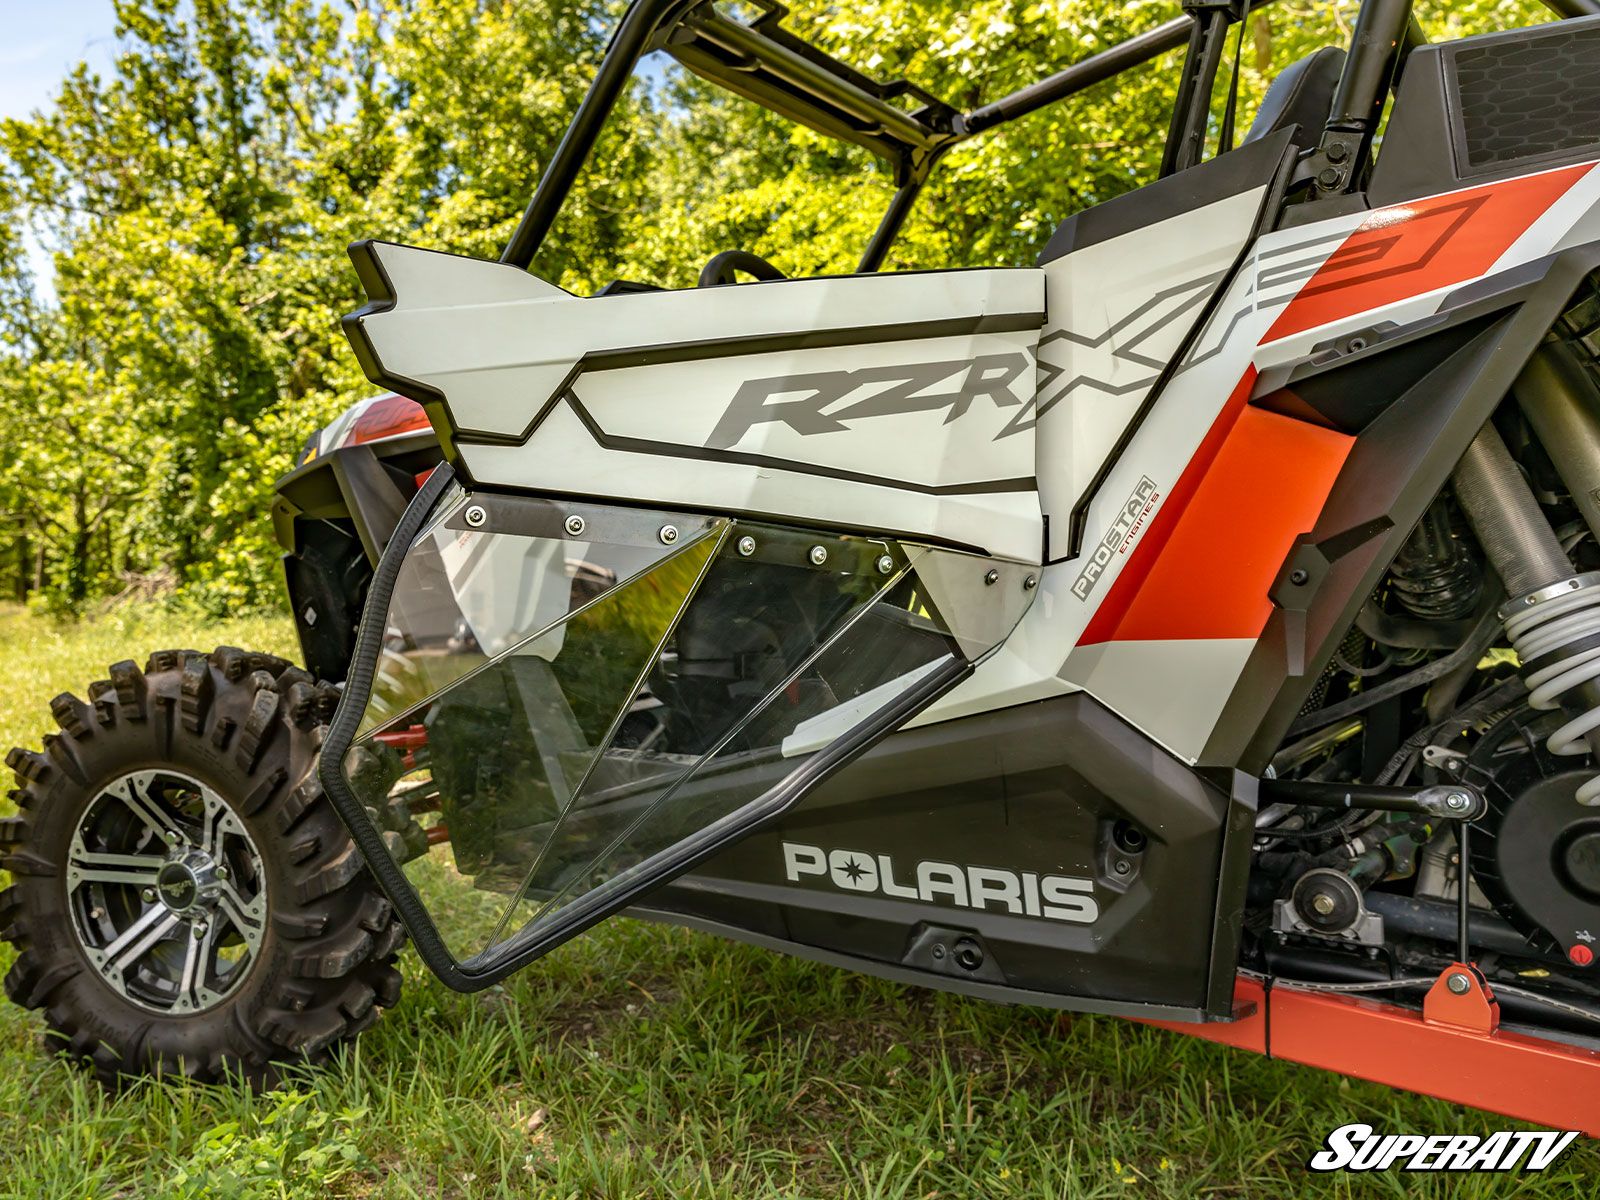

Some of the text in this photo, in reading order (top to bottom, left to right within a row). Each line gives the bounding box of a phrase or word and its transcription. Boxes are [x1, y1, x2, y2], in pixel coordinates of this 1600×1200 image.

[703, 352, 1029, 450] RZR
[1072, 479, 1155, 599] PROSTAR
[1119, 492, 1160, 554] ENGINES
[782, 842, 1099, 924] POLARIS
